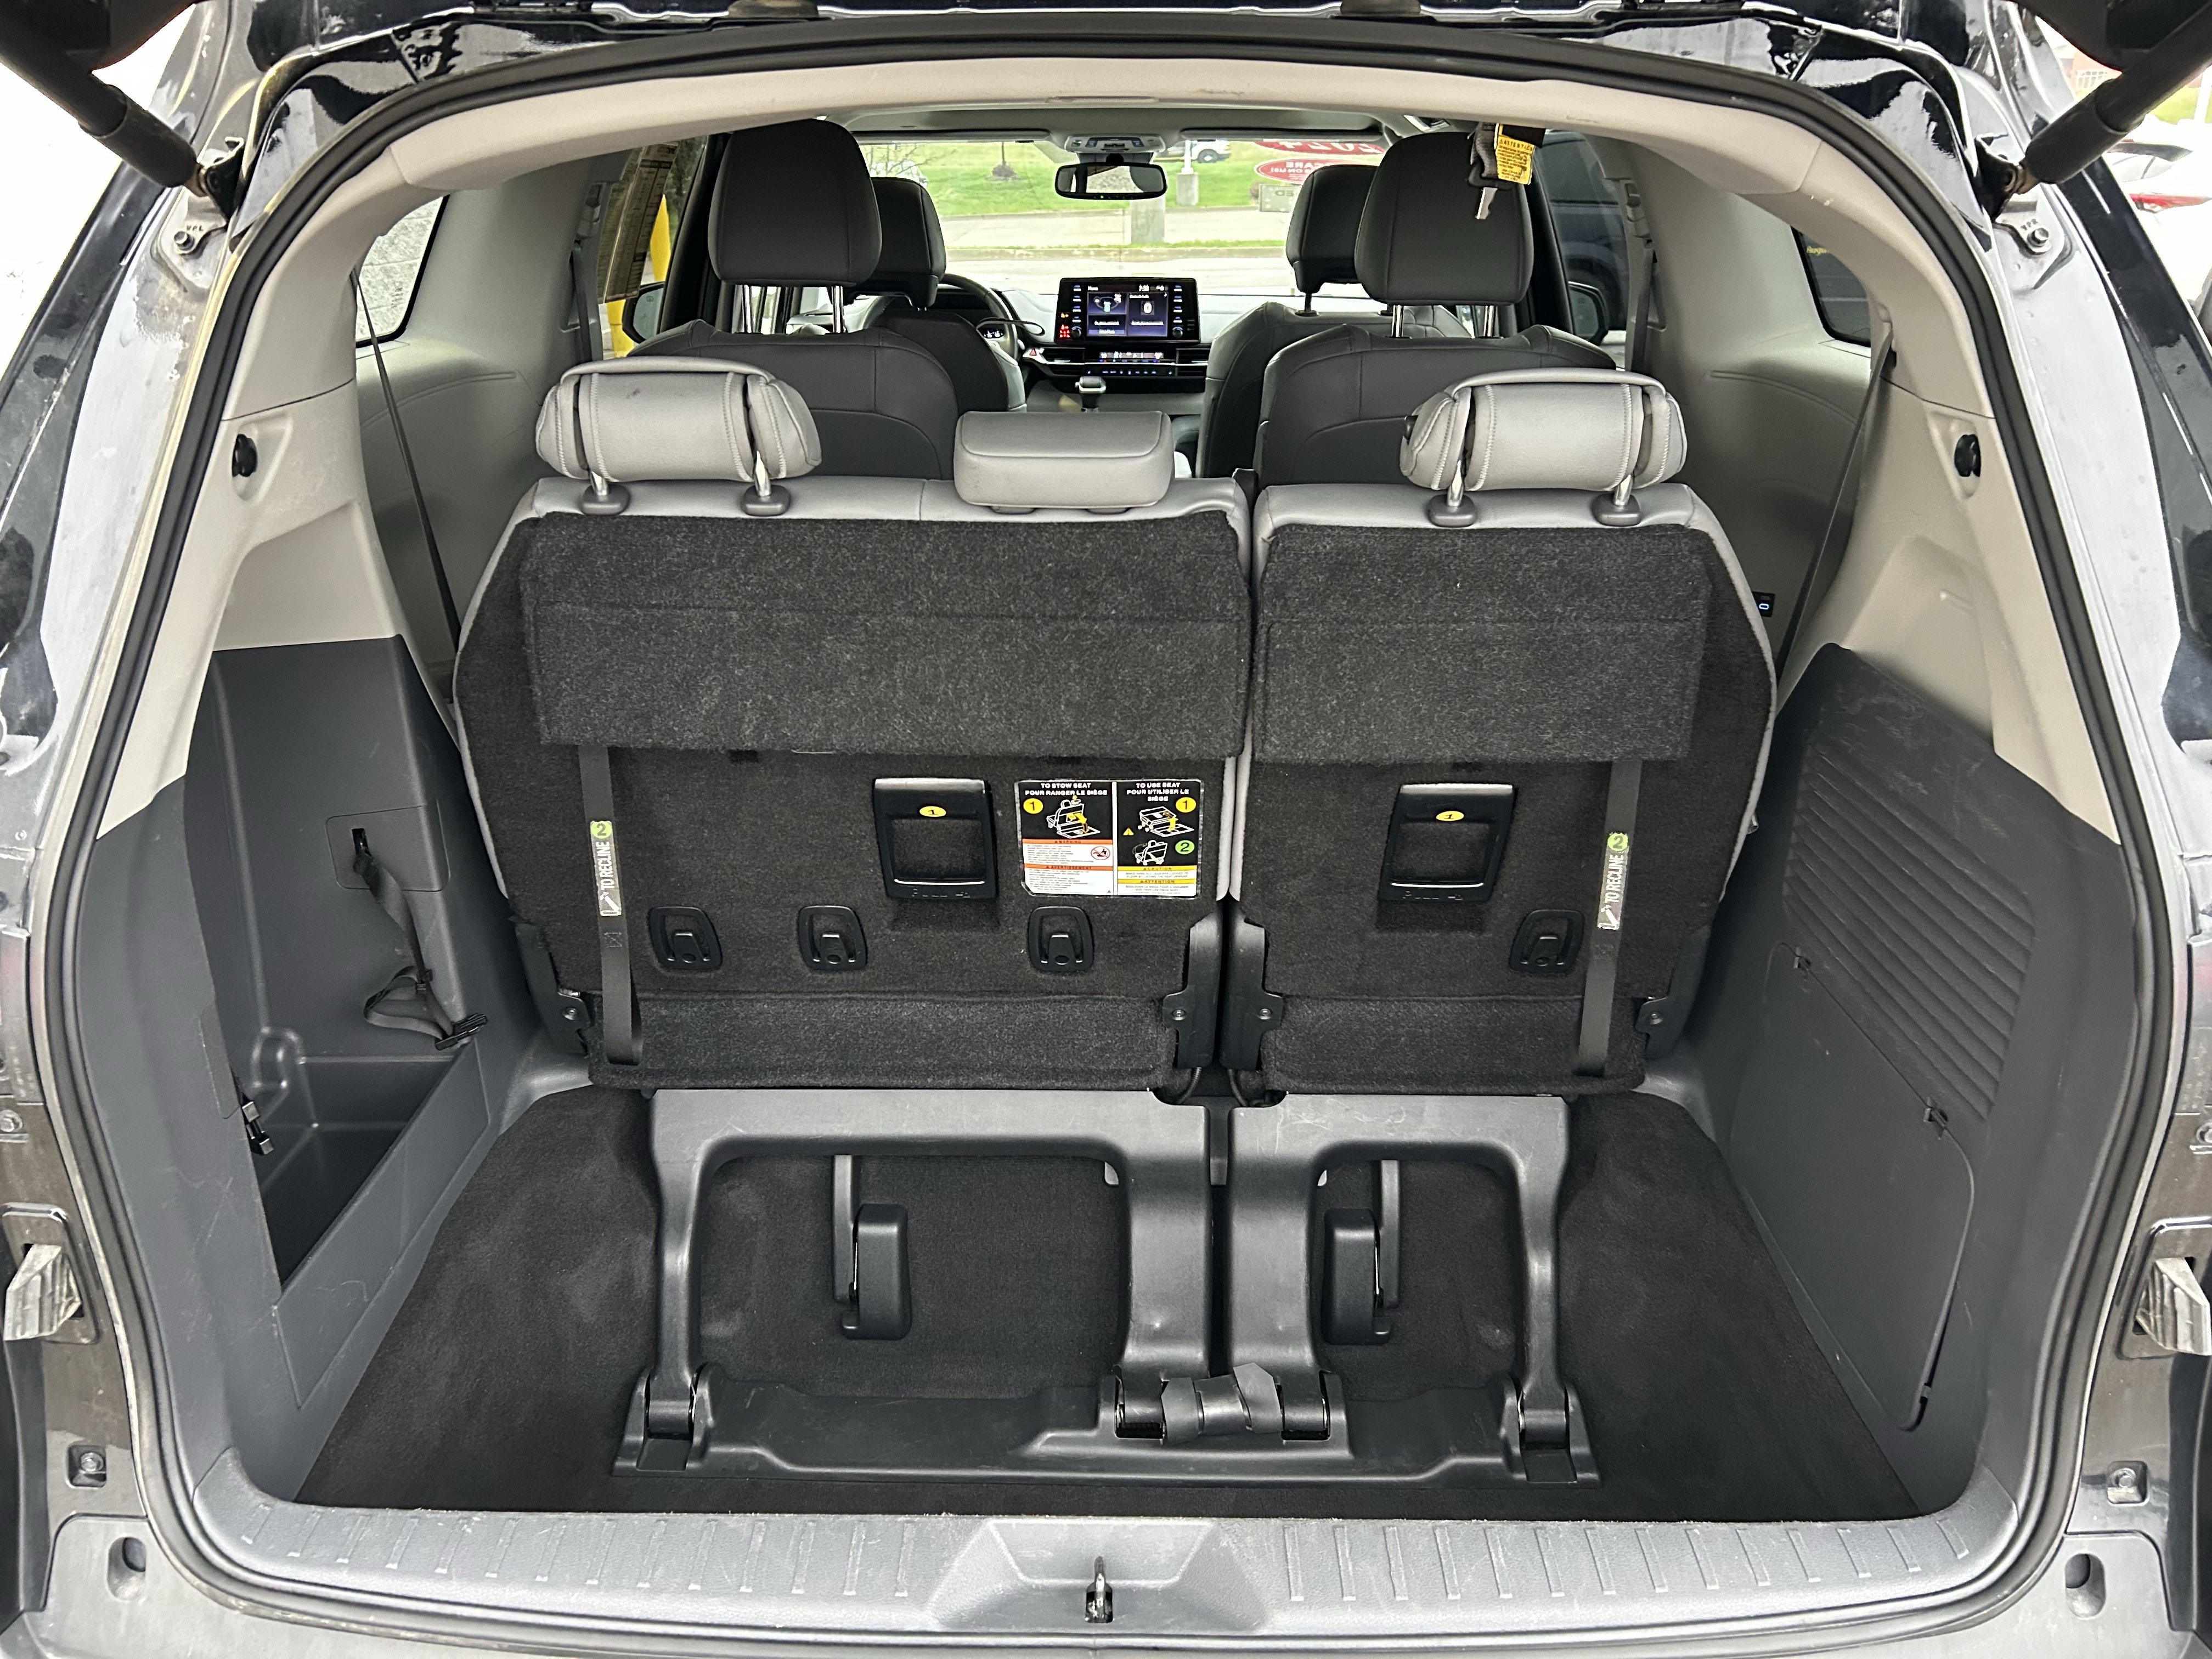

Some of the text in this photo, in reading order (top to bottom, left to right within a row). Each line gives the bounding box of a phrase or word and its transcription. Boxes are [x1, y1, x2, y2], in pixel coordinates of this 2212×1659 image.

[1504, 140, 1533, 151] ATTENTION
[596, 822, 606, 837] 2
[1180, 842, 1189, 852] 2
[1612, 836, 1624, 849] 2
[596, 841, 615, 890] TO RECLINE
[1604, 854, 1624, 904] TO RECLINE
